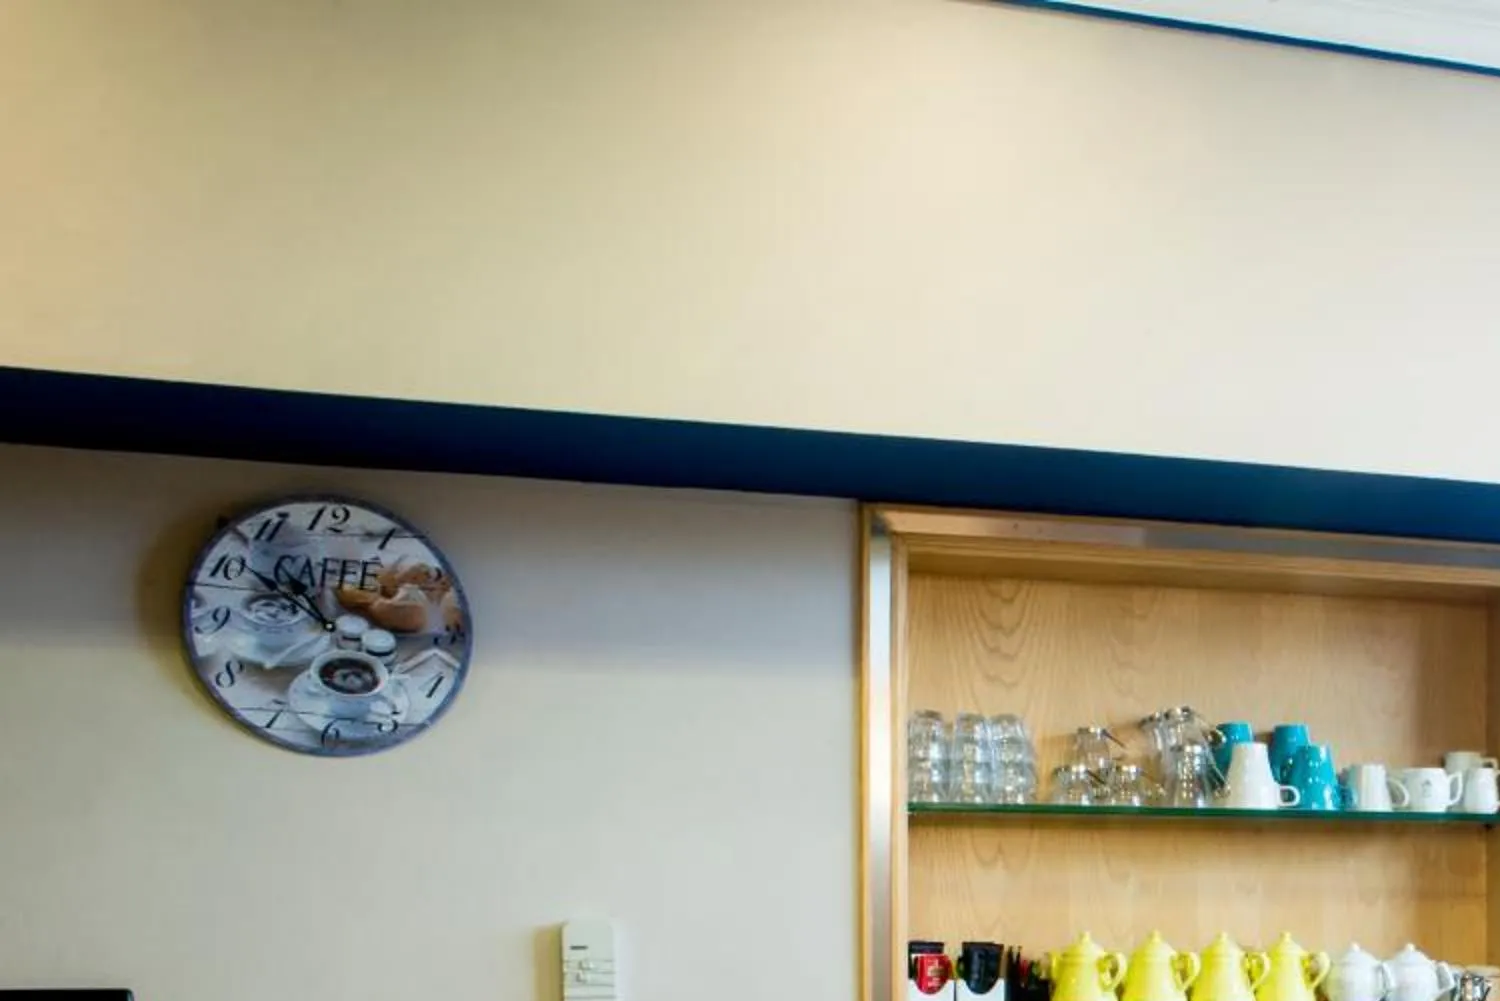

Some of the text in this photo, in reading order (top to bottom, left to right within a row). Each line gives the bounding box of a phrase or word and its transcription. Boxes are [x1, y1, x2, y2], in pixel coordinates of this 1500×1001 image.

[255, 512, 290, 542] 11
[307, 505, 351, 533] 12
[377, 527, 396, 550] 1
[209, 554, 247, 580] 10
[194, 605, 231, 634] 9
[215, 659, 243, 688] 8
[264, 699, 288, 729] 7
